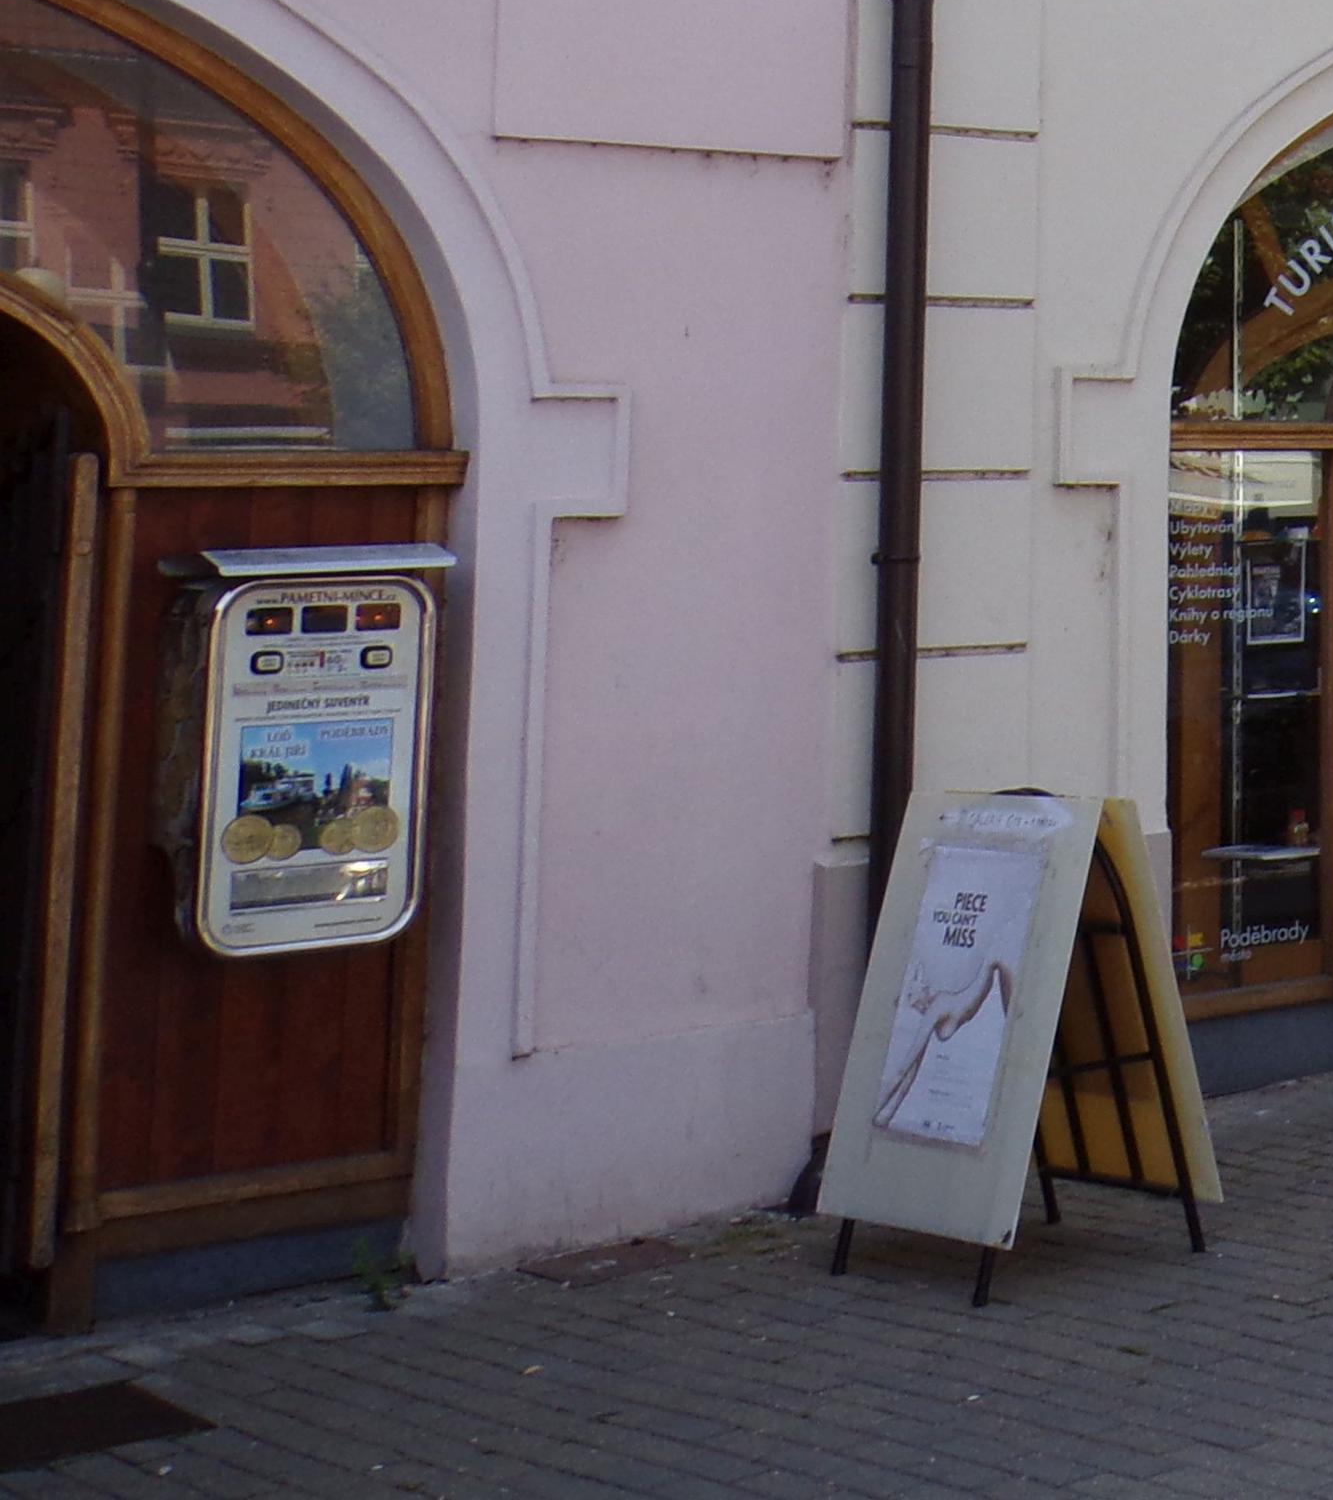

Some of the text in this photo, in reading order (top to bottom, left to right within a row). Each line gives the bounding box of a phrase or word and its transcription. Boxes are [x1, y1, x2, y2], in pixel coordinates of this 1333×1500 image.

[1170, 518, 1237, 538] Ubytován
[1170, 541, 1214, 560] Výlety
[1169, 583, 1240, 604] Cyklotrasy
[1169, 606, 1208, 625] Knihy
[1210, 611, 1220, 620] o
[1169, 627, 1211, 646] Dárky
[954, 892, 988, 912] PIECE
[933, 910, 951, 924] YOU
[943, 926, 976, 948] MISS
[1220, 920, 1309, 948] Poděbrady
